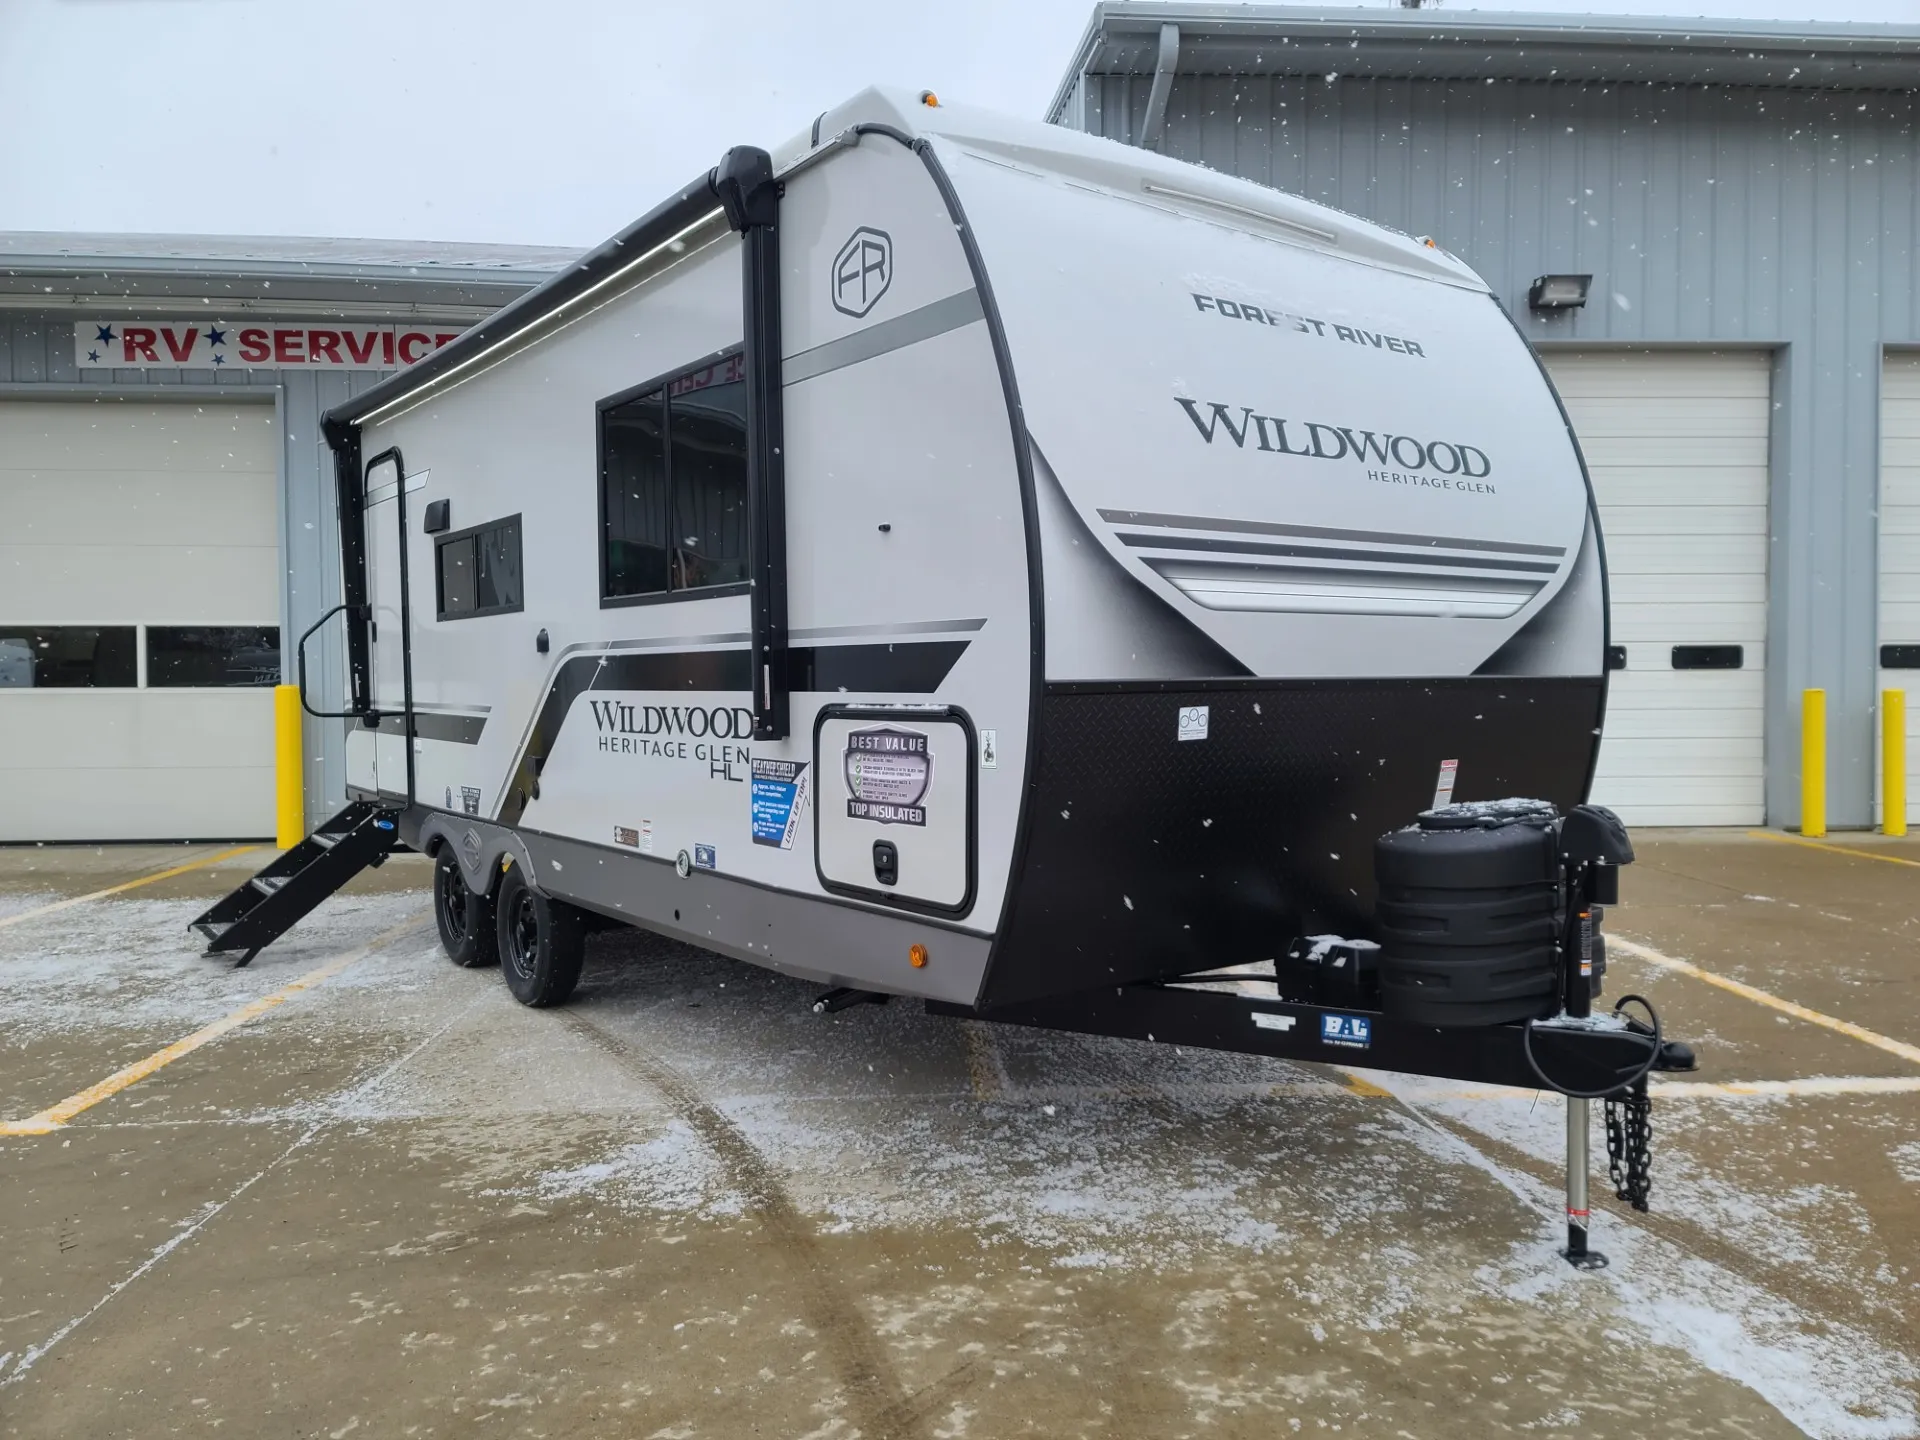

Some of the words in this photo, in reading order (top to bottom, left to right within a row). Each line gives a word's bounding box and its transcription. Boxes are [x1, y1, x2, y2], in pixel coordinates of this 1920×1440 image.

[122, 328, 199, 362] RV
[1332, 323, 1427, 358] RIVER
[1367, 469, 1452, 490] HERITAGE
[1456, 480, 1497, 494] GLEN
[599, 736, 687, 759] HERITAGE
[695, 744, 750, 764] GLEN
[851, 735, 880, 749] BEST
[885, 737, 924, 752] VALUE
[710, 762, 744, 782] HL
[785, 820, 796, 844] LOOK
[793, 801, 800, 816] UP
[850, 801, 868, 816] TOP
[869, 804, 923, 823] INSULATED
